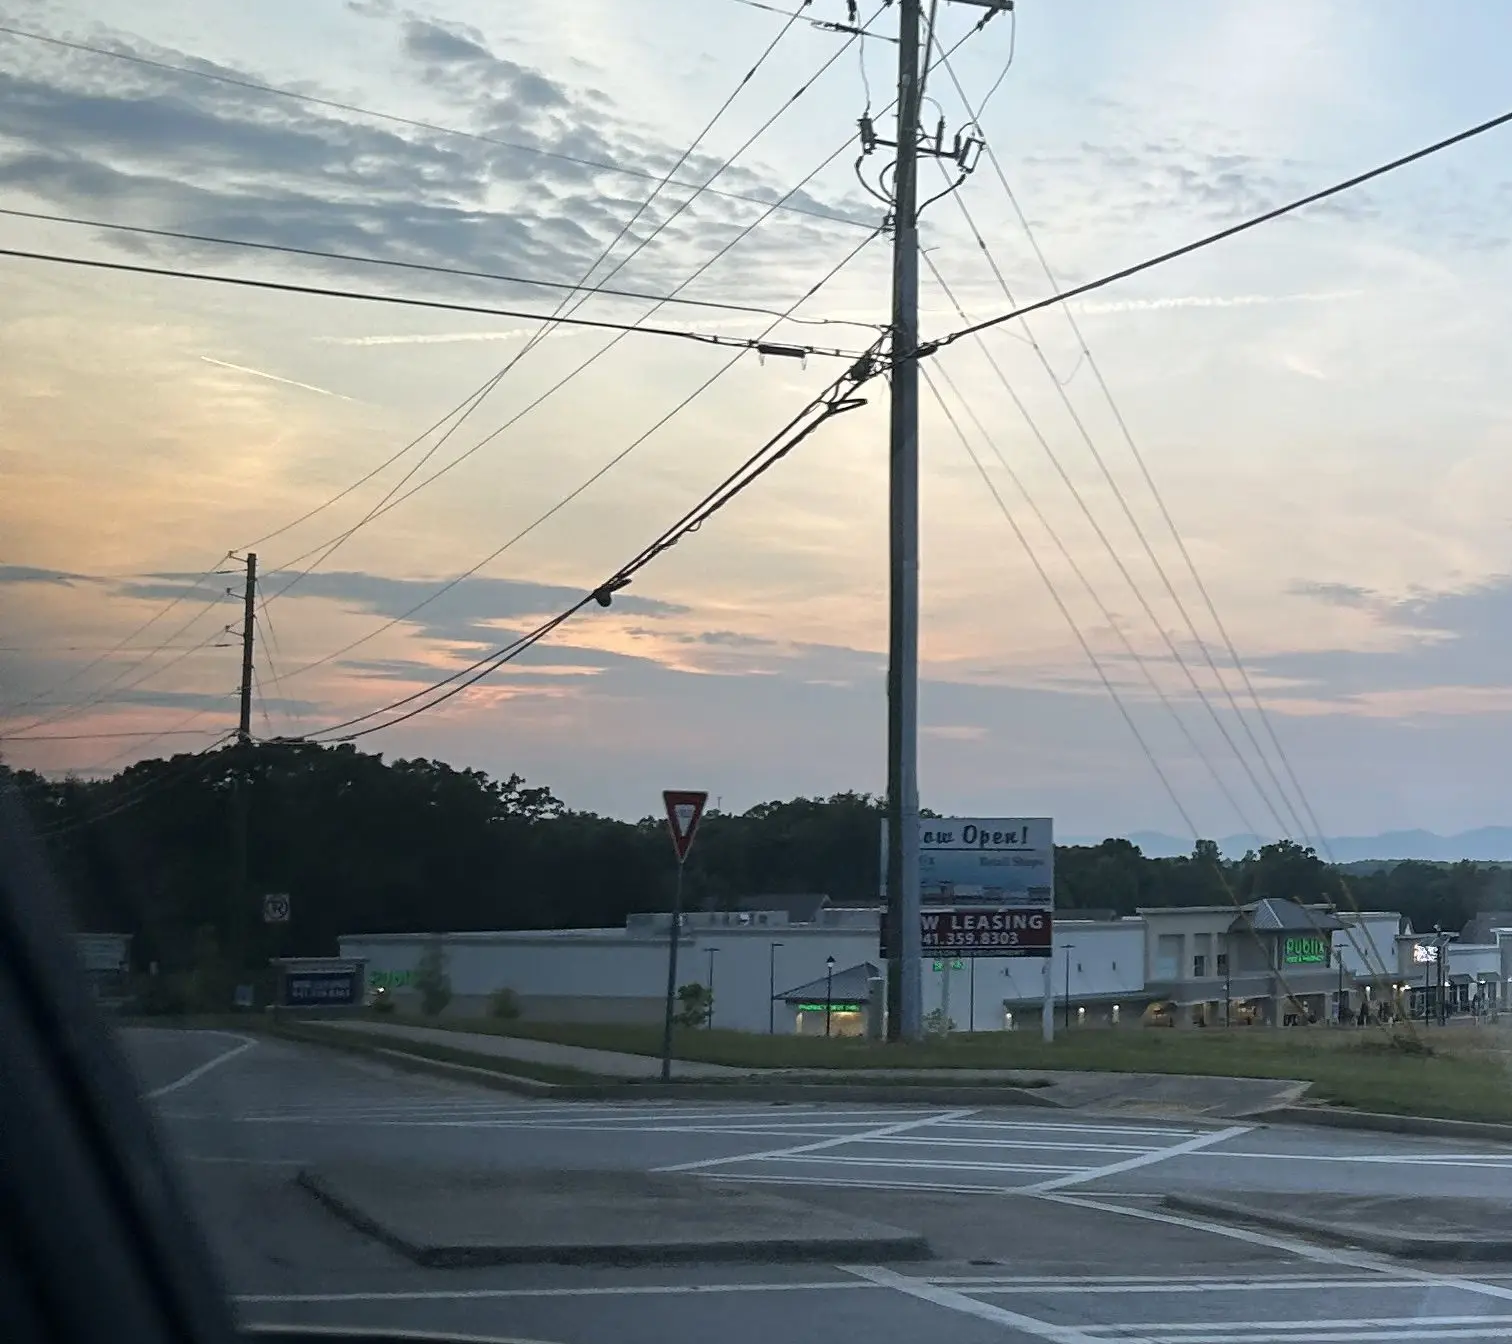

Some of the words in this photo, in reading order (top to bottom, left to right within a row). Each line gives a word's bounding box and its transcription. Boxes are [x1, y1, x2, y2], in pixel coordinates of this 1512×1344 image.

[923, 830, 954, 844] ow
[962, 824, 1028, 849] Open!
[950, 914, 1045, 930] LEASING
[921, 931, 1020, 946] 41.359.8303
[1286, 937, 1325, 955] Publix
